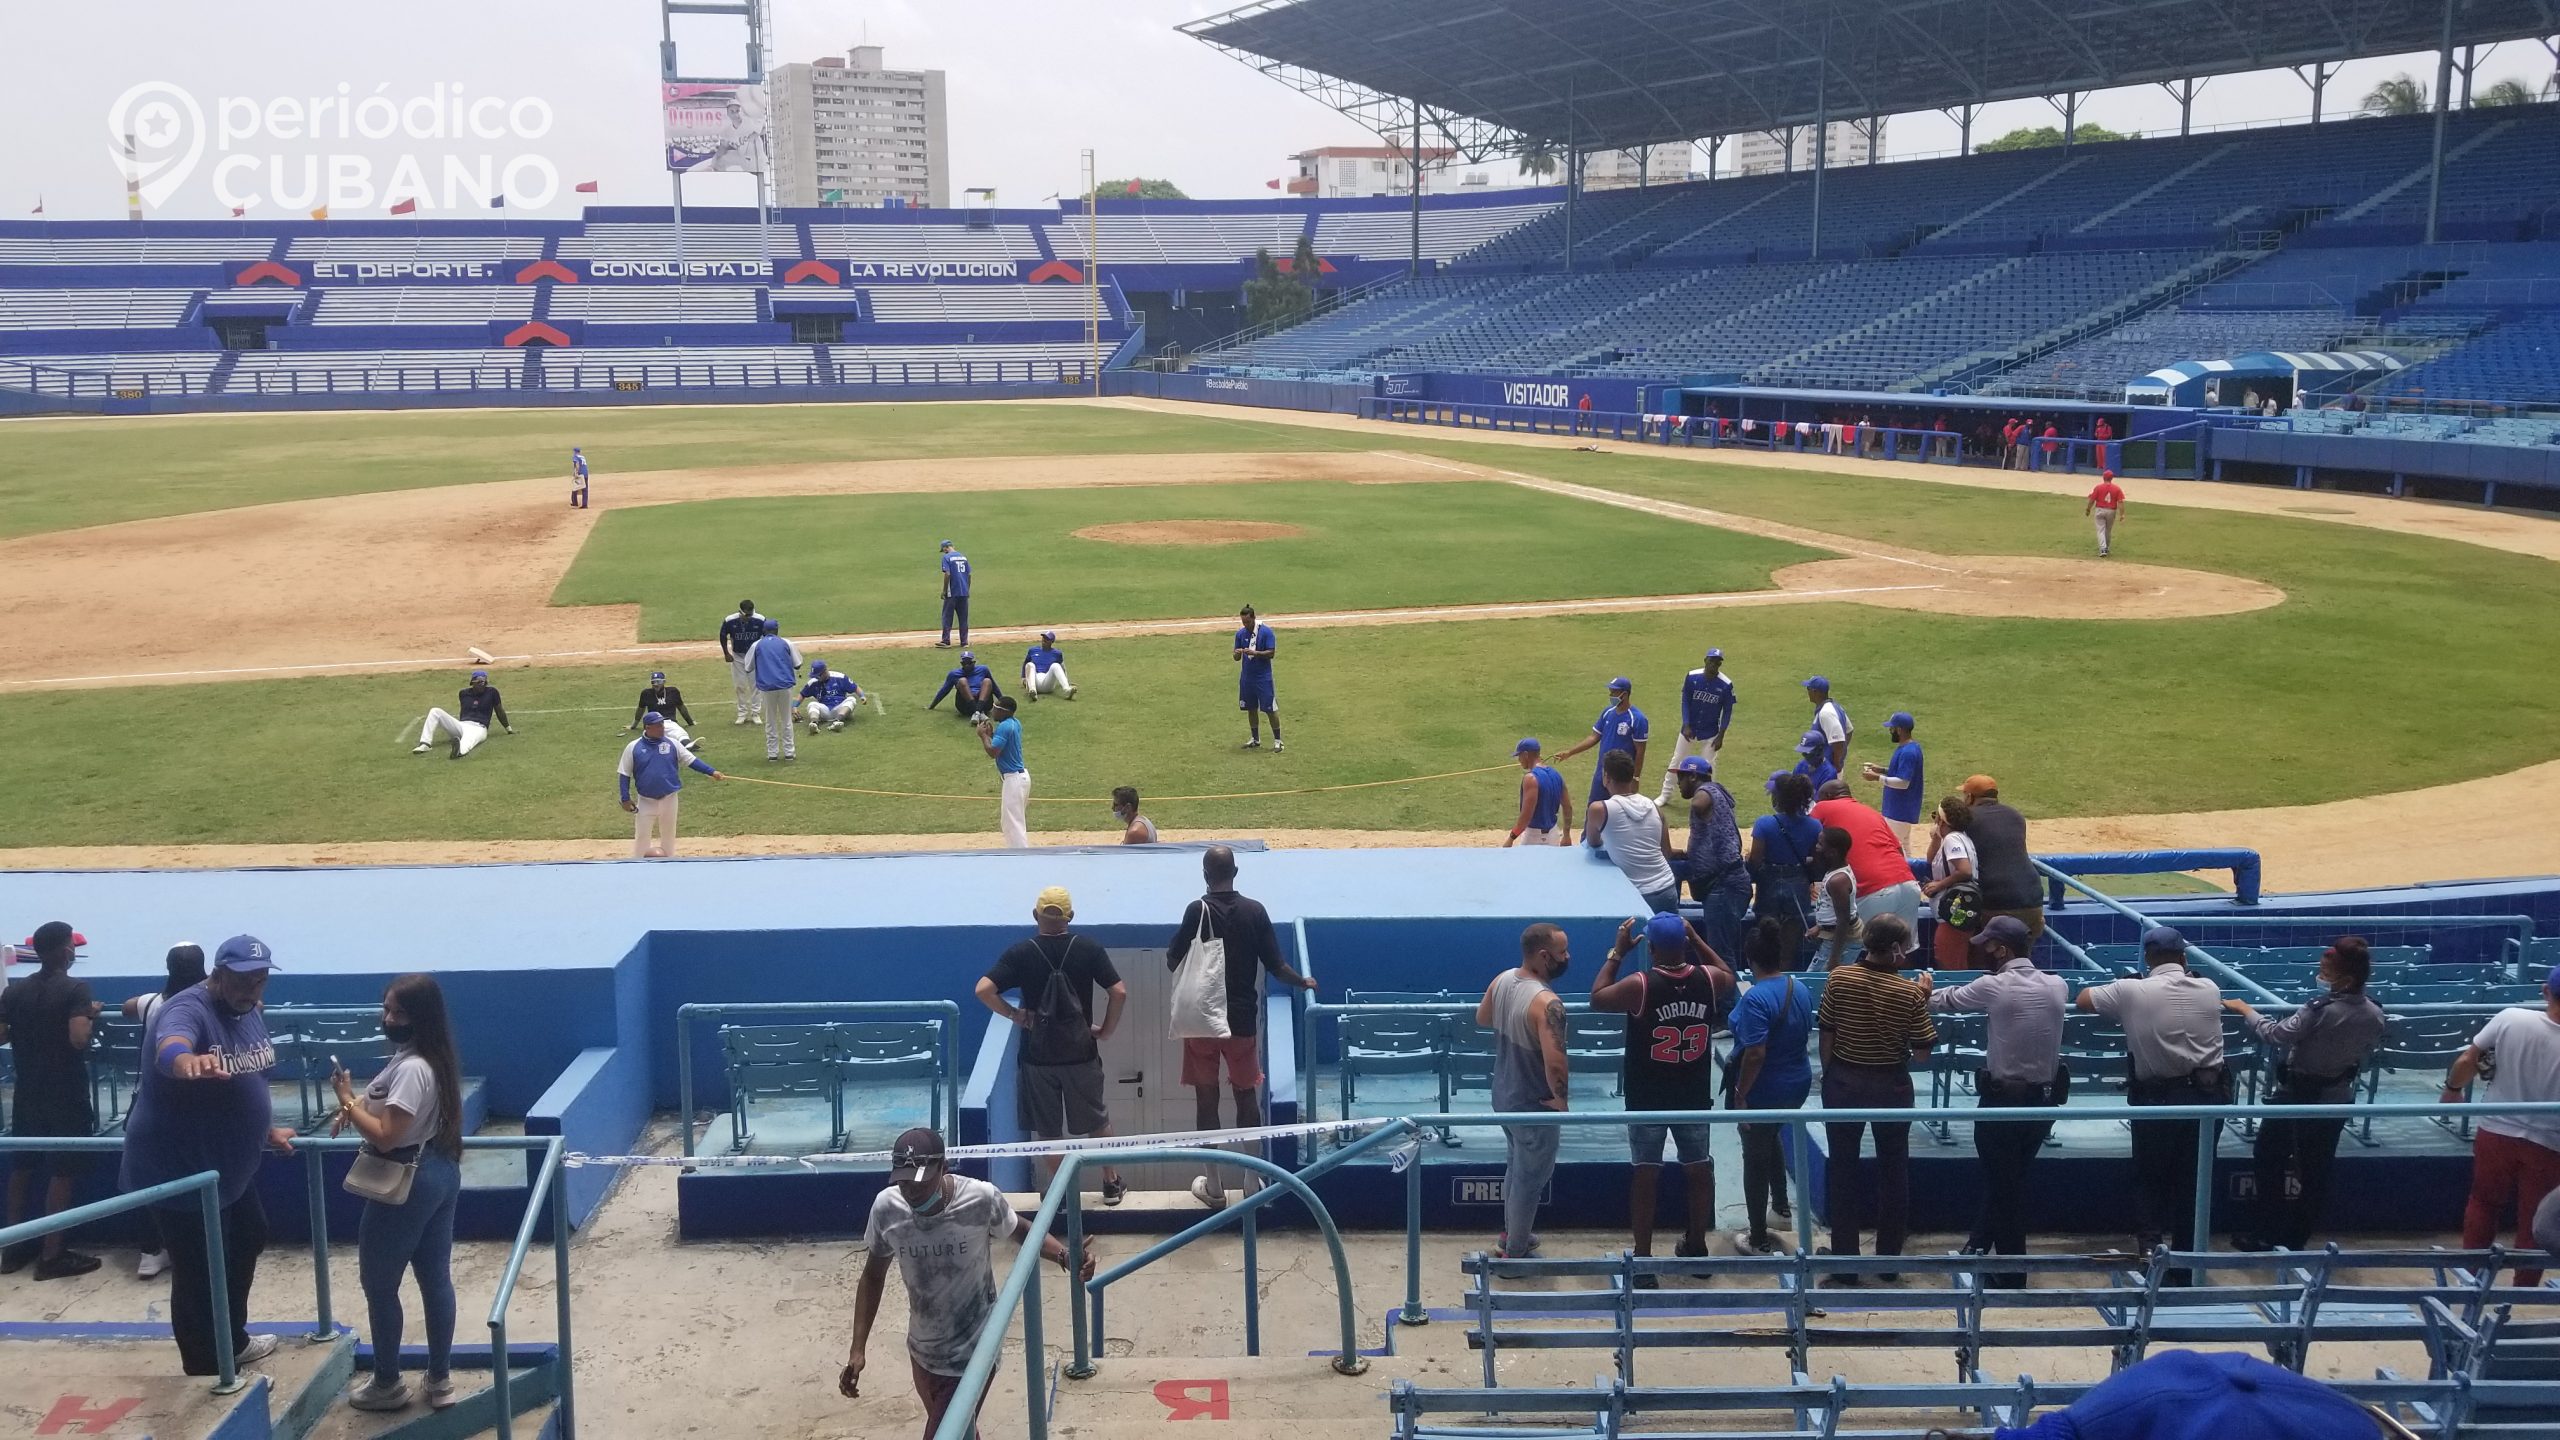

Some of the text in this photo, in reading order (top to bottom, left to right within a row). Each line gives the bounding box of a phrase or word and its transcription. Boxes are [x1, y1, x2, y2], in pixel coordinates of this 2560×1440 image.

[313, 263, 349, 278] EL
[590, 262, 774, 276] CONQUISTA DE
[849, 262, 877, 277] LA
[1503, 382, 1569, 408] VISITADOR
[2104, 491, 2112, 504] 4
[955, 560, 966, 573] 75
[1655, 1000, 1707, 1022] JORDAN
[1651, 1023, 1709, 1064] 23
[1461, 1181, 1507, 1201] PRE
[899, 1241, 969, 1258] FUTURE
[34, 1395, 144, 1436] H
